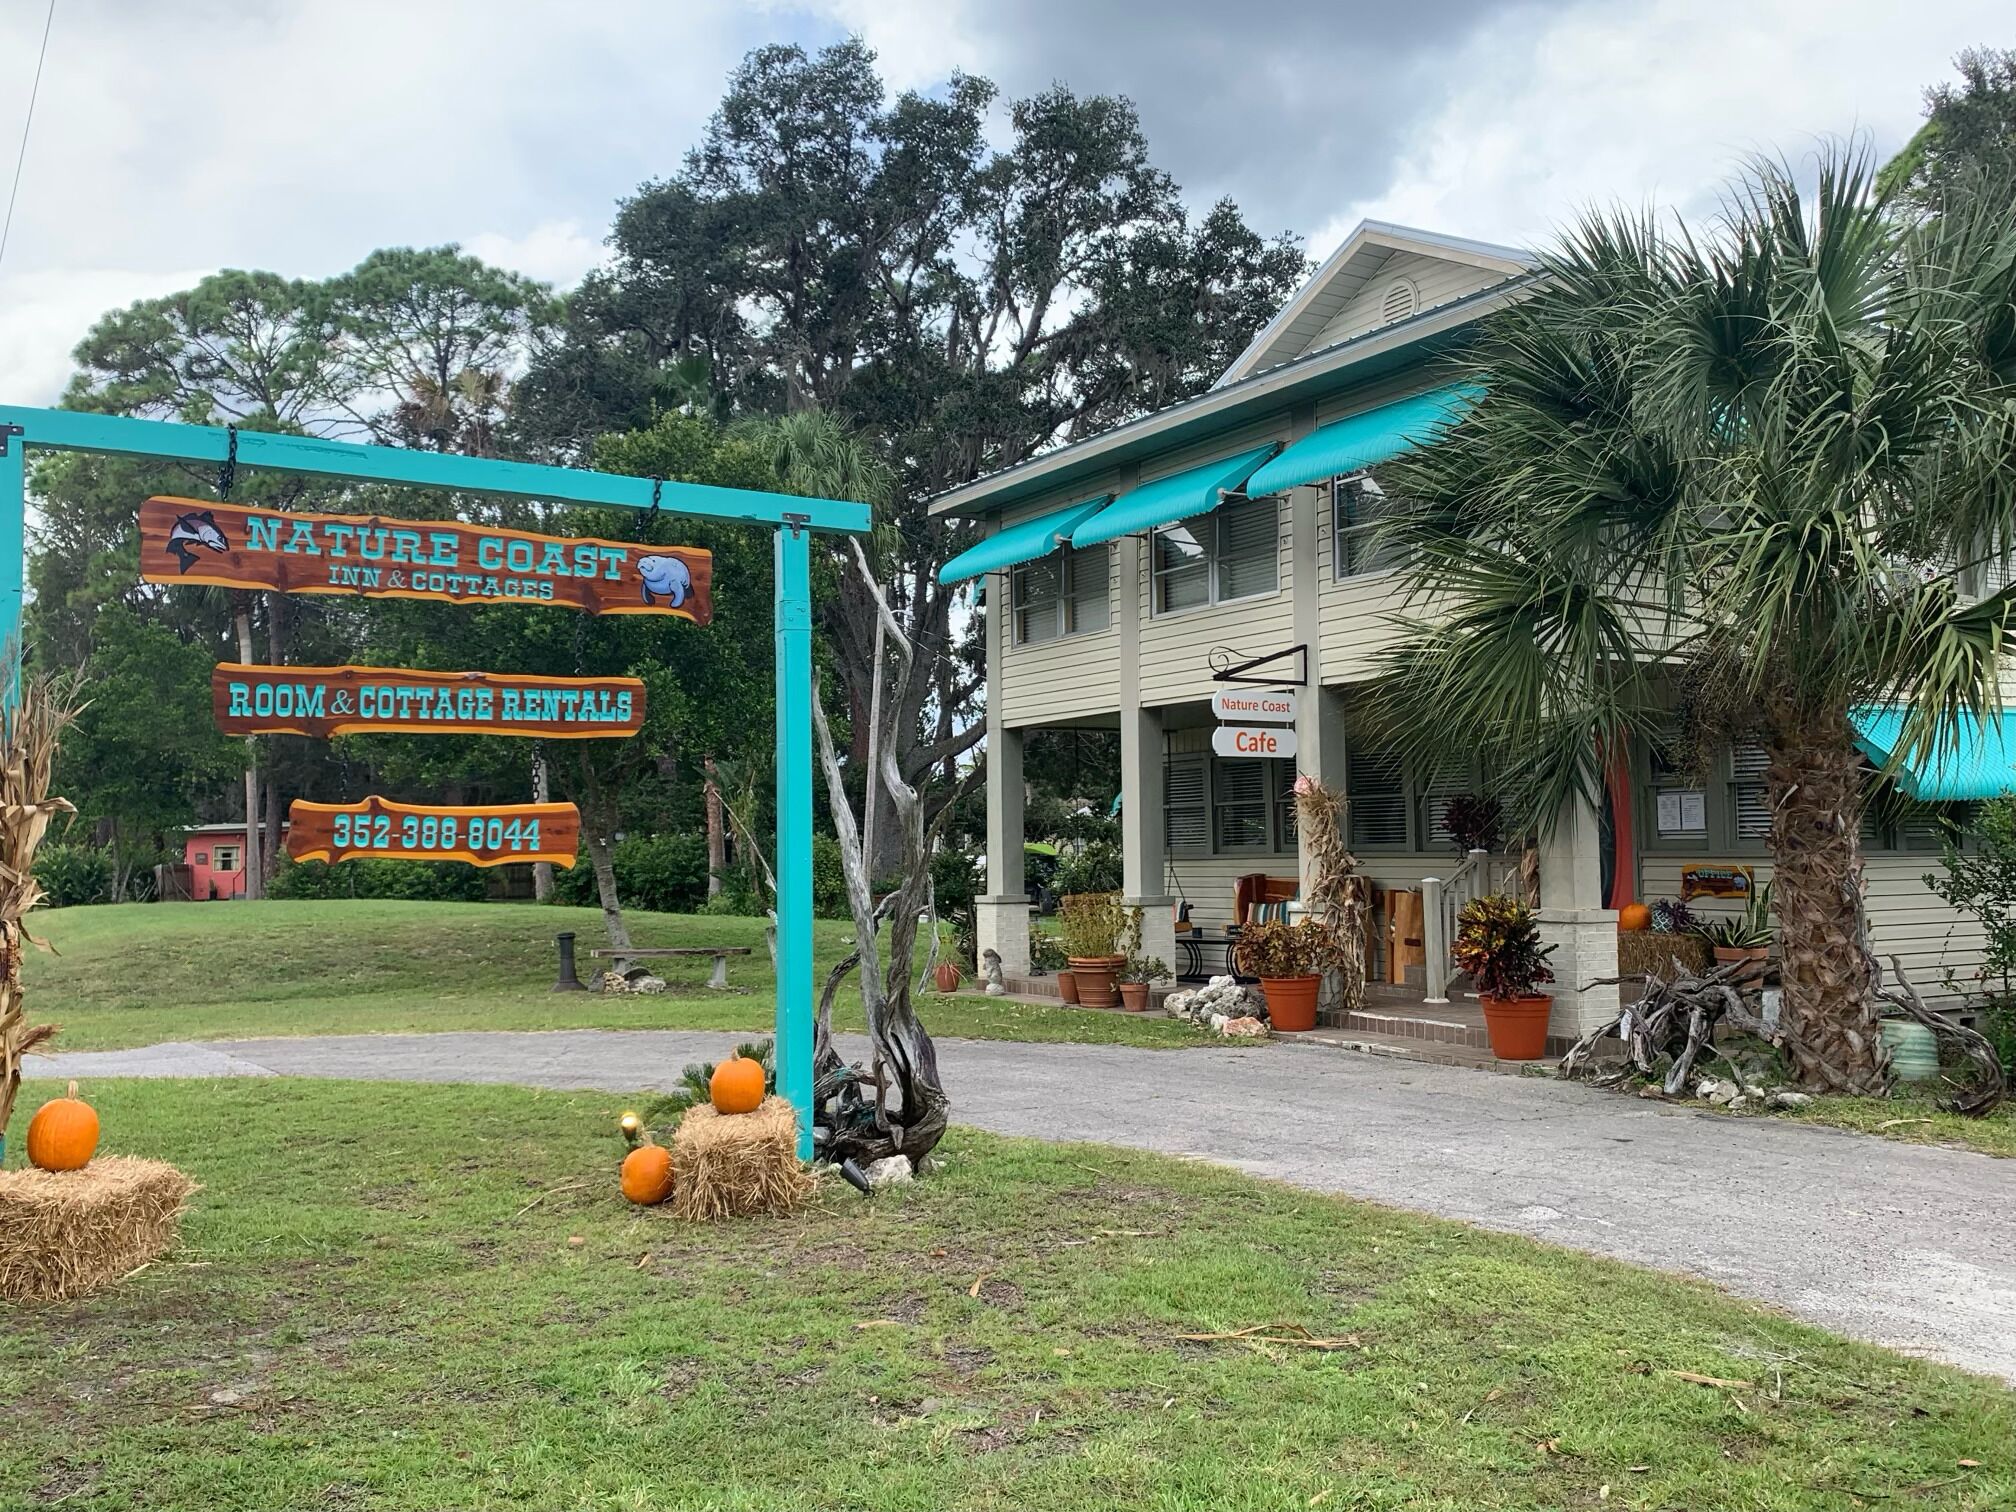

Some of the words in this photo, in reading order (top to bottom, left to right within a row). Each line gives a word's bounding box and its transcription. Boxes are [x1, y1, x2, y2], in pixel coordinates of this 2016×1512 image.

[245, 515, 459, 567] NATURE
[478, 536, 628, 581] COAST
[328, 564, 382, 588] INN
[387, 570, 406, 589] &
[411, 571, 554, 600] COTTAGES
[228, 682, 326, 718] ROOM
[330, 689, 355, 715] &
[359, 686, 494, 721] COTTAGE
[502, 688, 633, 723] RENTALS
[1221, 698, 1259, 711] Nature
[1262, 700, 1291, 713] Coast
[1235, 731, 1277, 753] Cafe
[332, 814, 541, 851] 352-388-8044
